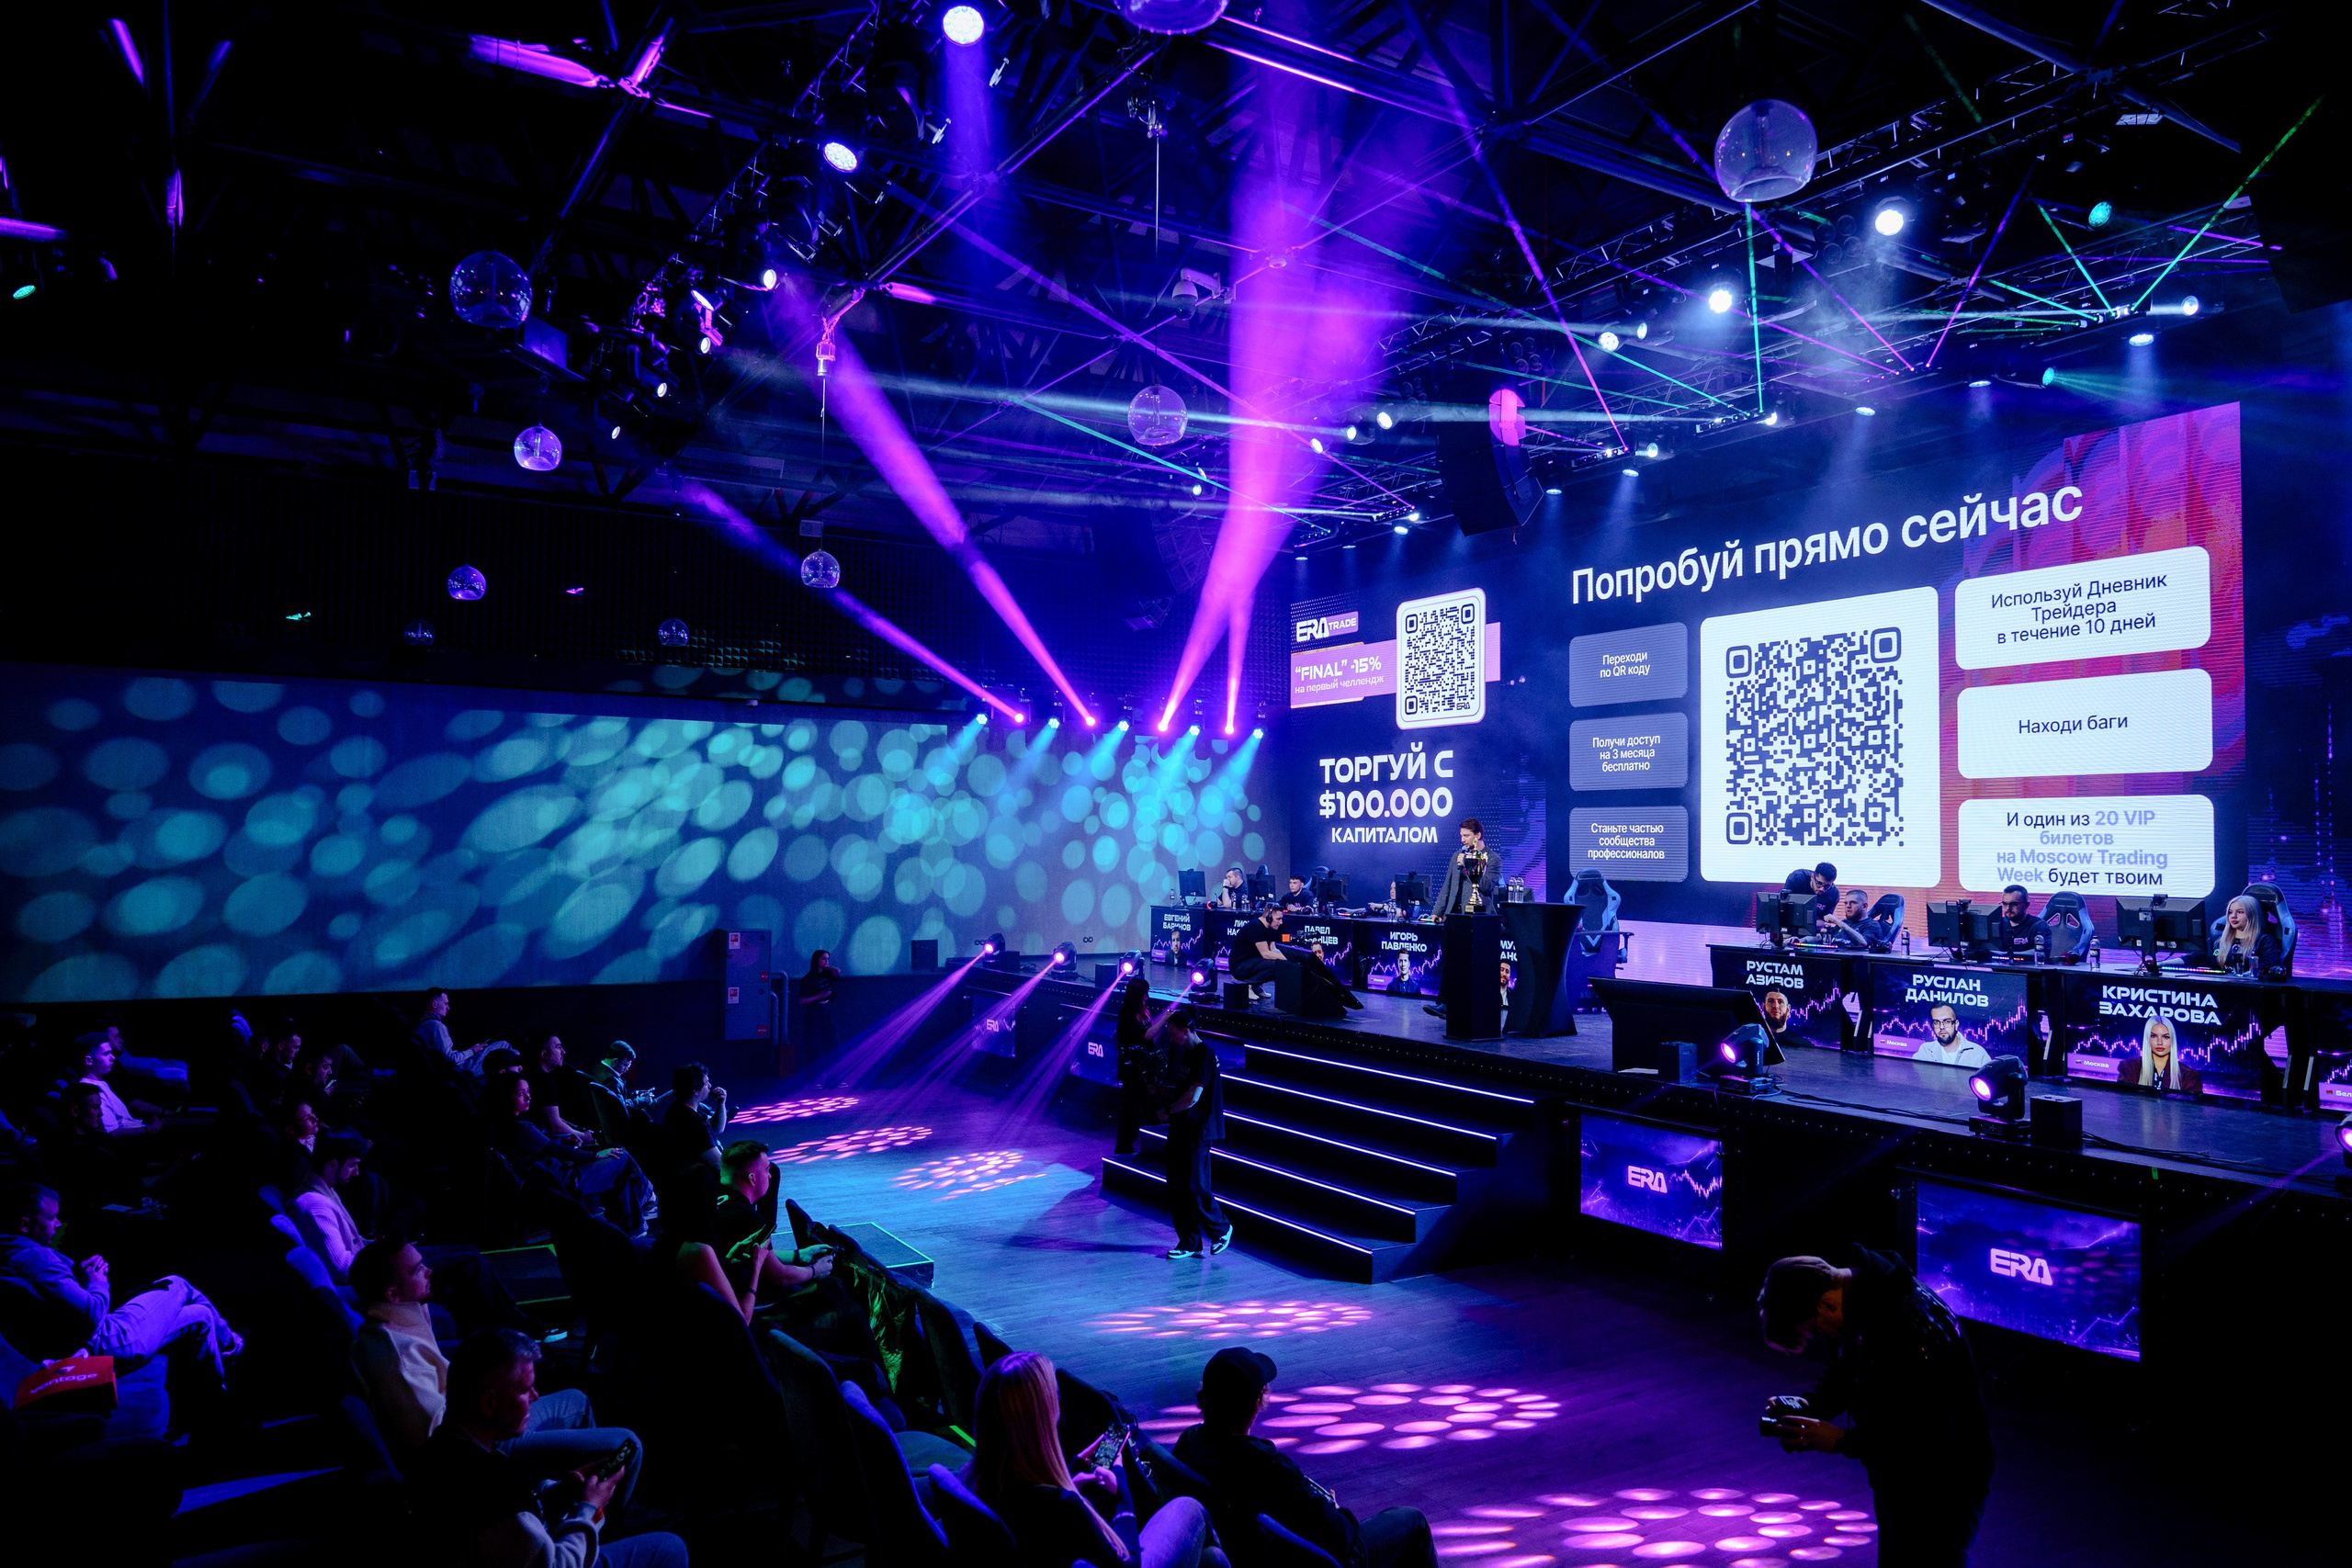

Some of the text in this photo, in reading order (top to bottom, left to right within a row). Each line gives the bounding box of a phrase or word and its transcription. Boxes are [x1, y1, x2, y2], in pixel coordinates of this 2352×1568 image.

[1571, 484, 2083, 604] Попробуй прямо сейчас
[1992, 574, 2167, 609] Используй Дневник
[2031, 600, 2117, 625] Трейдера
[1296, 617, 1357, 642] ERA TRADE
[1997, 613, 2156, 644] в течение 10 дней
[1351, 656, 1382, 674] -15%
[1602, 651, 1648, 666] Переходи
[1600, 664, 1651, 678] по QR коду
[1295, 675, 1385, 694] на первый челлендж
[2018, 715, 2129, 735] Находи баги
[1592, 735, 1661, 750] Получи доступ
[1319, 741, 1453, 784] ТОРГУЙ С
[1600, 749, 1656, 760] на 3 месяца
[1601, 761, 1651, 773] бесплатно
[1319, 786, 1453, 819] $100.000
[1590, 823, 1664, 834] Станьте частью
[2007, 810, 2156, 829] И один из 20 VIP
[1331, 827, 1439, 843] КАПИТАЛОМ
[1599, 835, 1656, 847] сообщества
[2040, 830, 2114, 845] билетов
[1588, 848, 1665, 860] профессионалов
[1996, 850, 2168, 869] на Moscow Trading
[1996, 868, 2163, 886] Week будет твоим
[1164, 913, 1190, 923] ЕВГЕНИЙ
[1389, 931, 1419, 942] ИГОРЬ
[1381, 941, 1428, 953] ПАВЛЕНКО
[1746, 960, 1804, 976] РУСТАМ
[1746, 974, 1804, 989] АЗИЗОВ
[1913, 974, 1981, 992] РУСЛАН
[1905, 987, 1989, 1007] ДАНИЛОВ
[2102, 985, 2219, 1009] КРИСТИНА
[2098, 1000, 2222, 1026] ЗАХАРОВА
[2083, 1060, 2109, 1068] Москва
[1628, 1165, 1668, 1193] ERA
[1990, 1247, 2053, 1286] ERA
